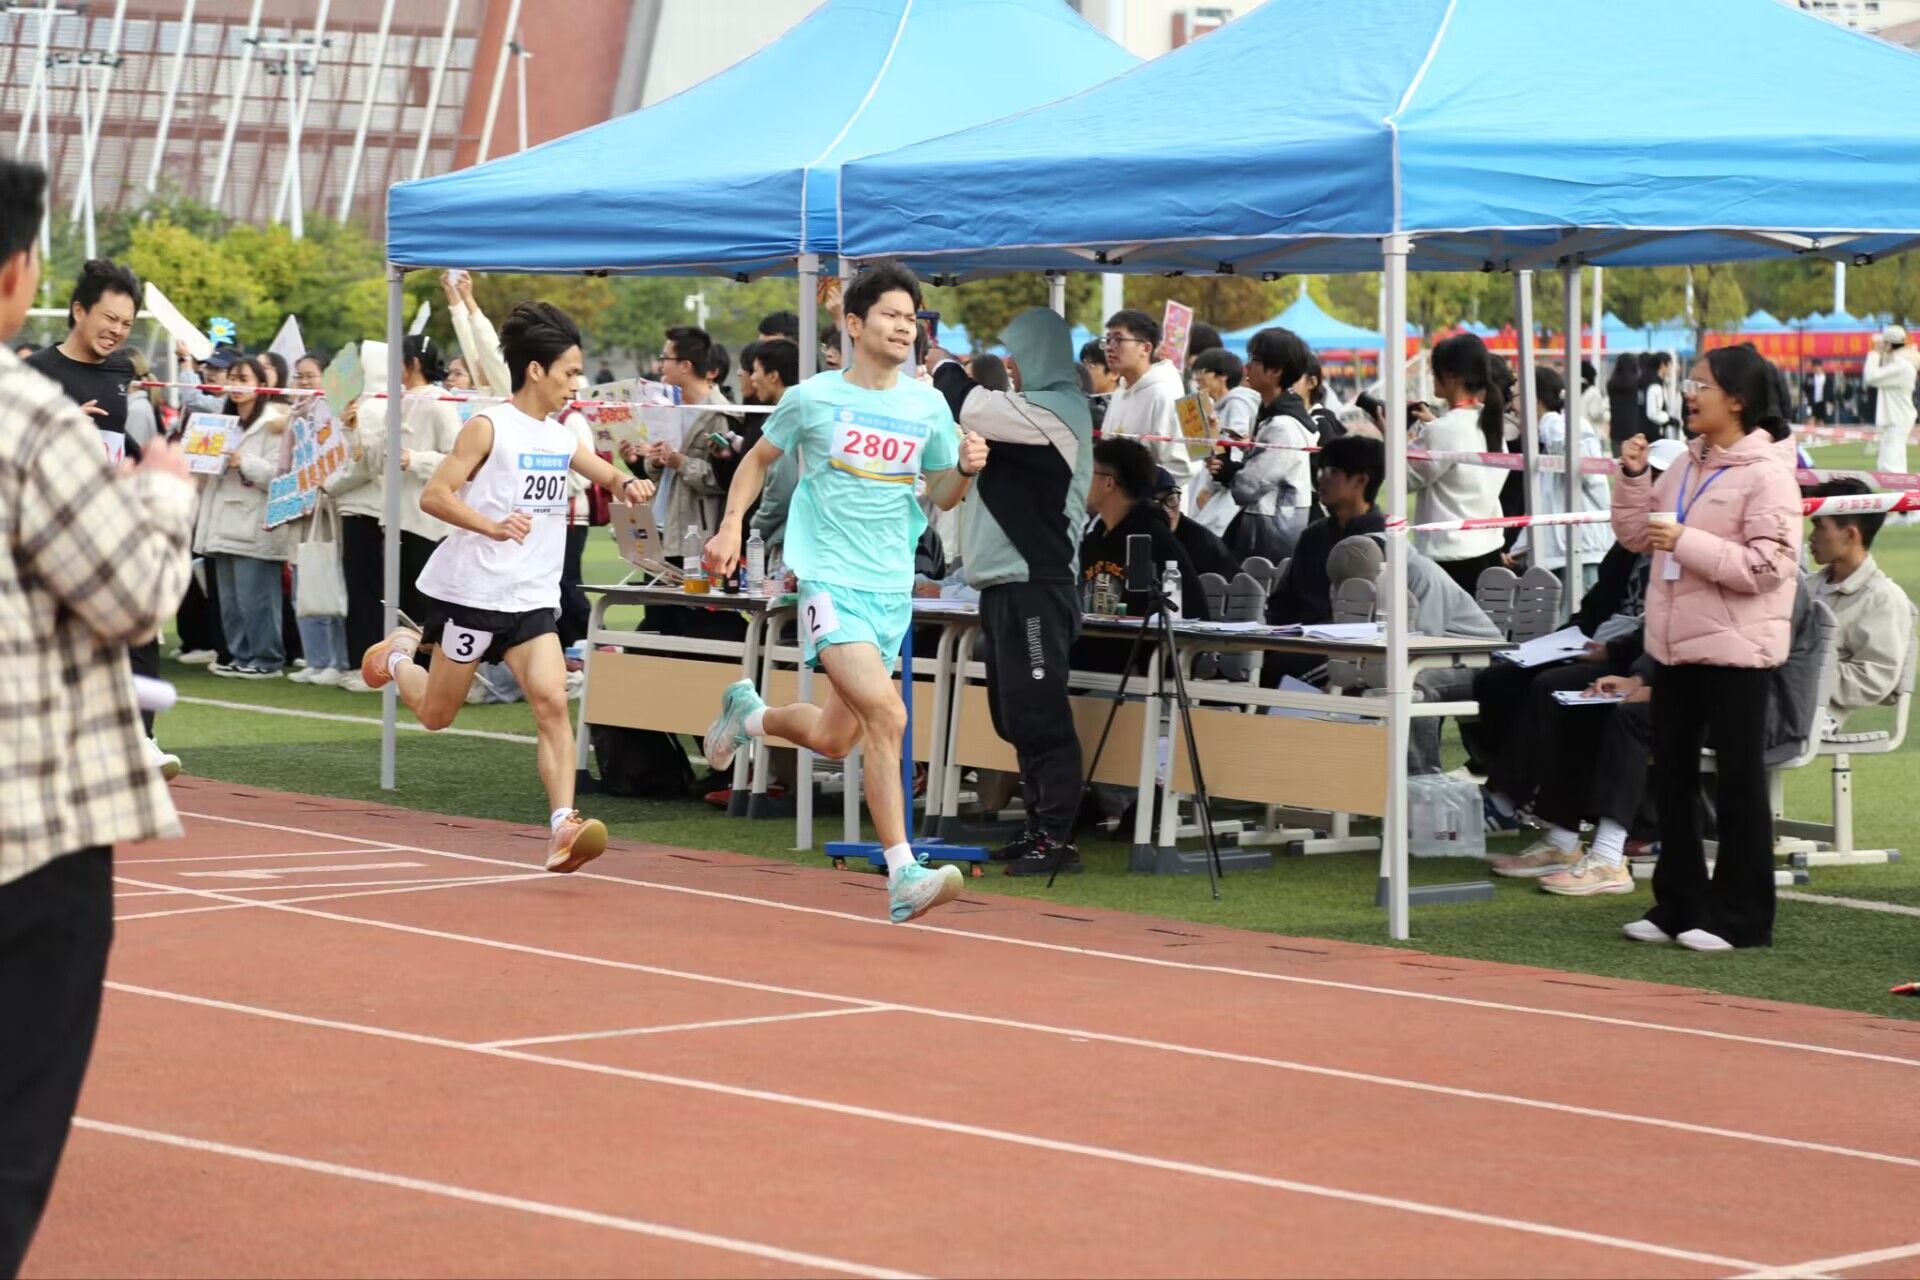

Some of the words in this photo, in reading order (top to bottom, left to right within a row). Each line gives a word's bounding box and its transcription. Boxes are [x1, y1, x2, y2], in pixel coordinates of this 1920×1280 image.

[843, 430, 916, 464] 2807
[523, 475, 566, 501] 2907
[807, 605, 821, 633] 2
[456, 633, 475, 656] 3
